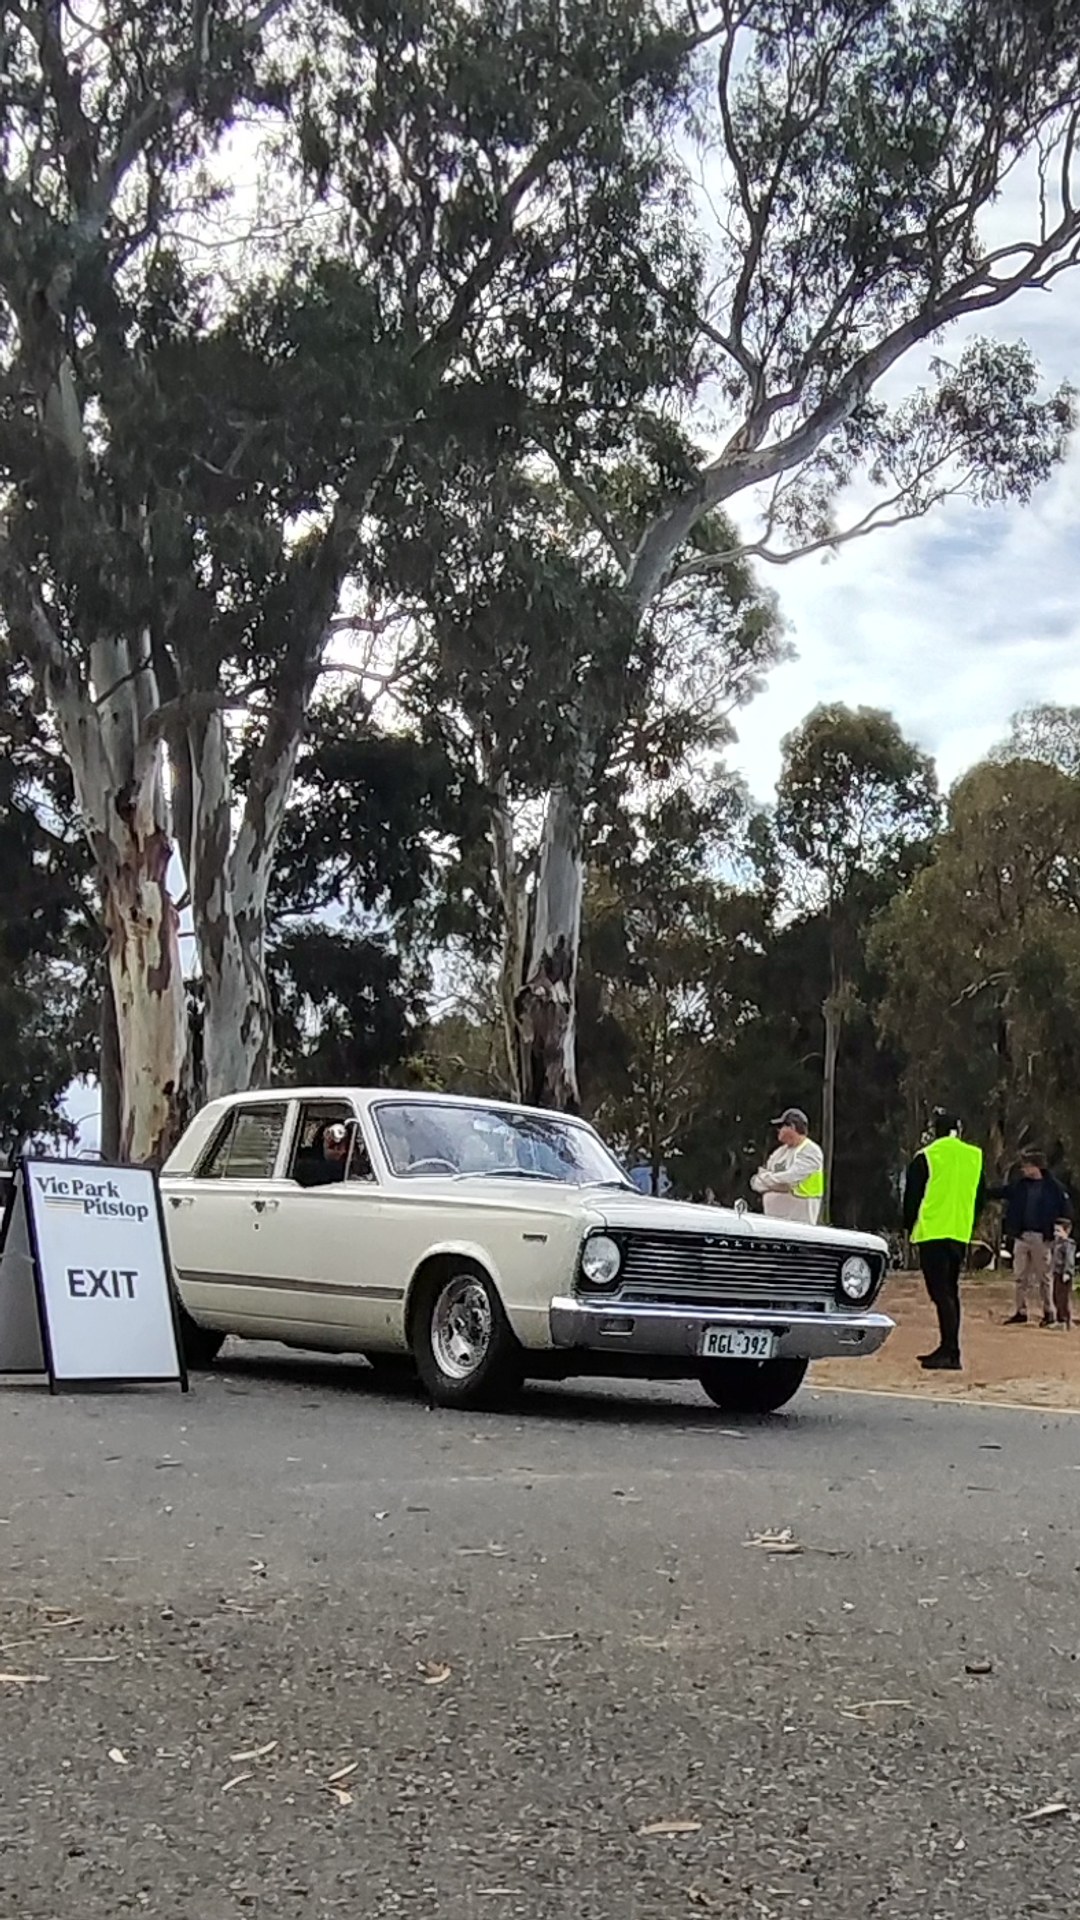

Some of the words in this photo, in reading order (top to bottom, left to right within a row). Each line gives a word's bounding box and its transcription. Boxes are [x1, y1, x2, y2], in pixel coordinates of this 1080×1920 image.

[34, 1176, 69, 1195] Vic
[71, 1179, 120, 1198] Park
[83, 1198, 149, 1222] Pitstop
[67, 1269, 139, 1298] EXIT
